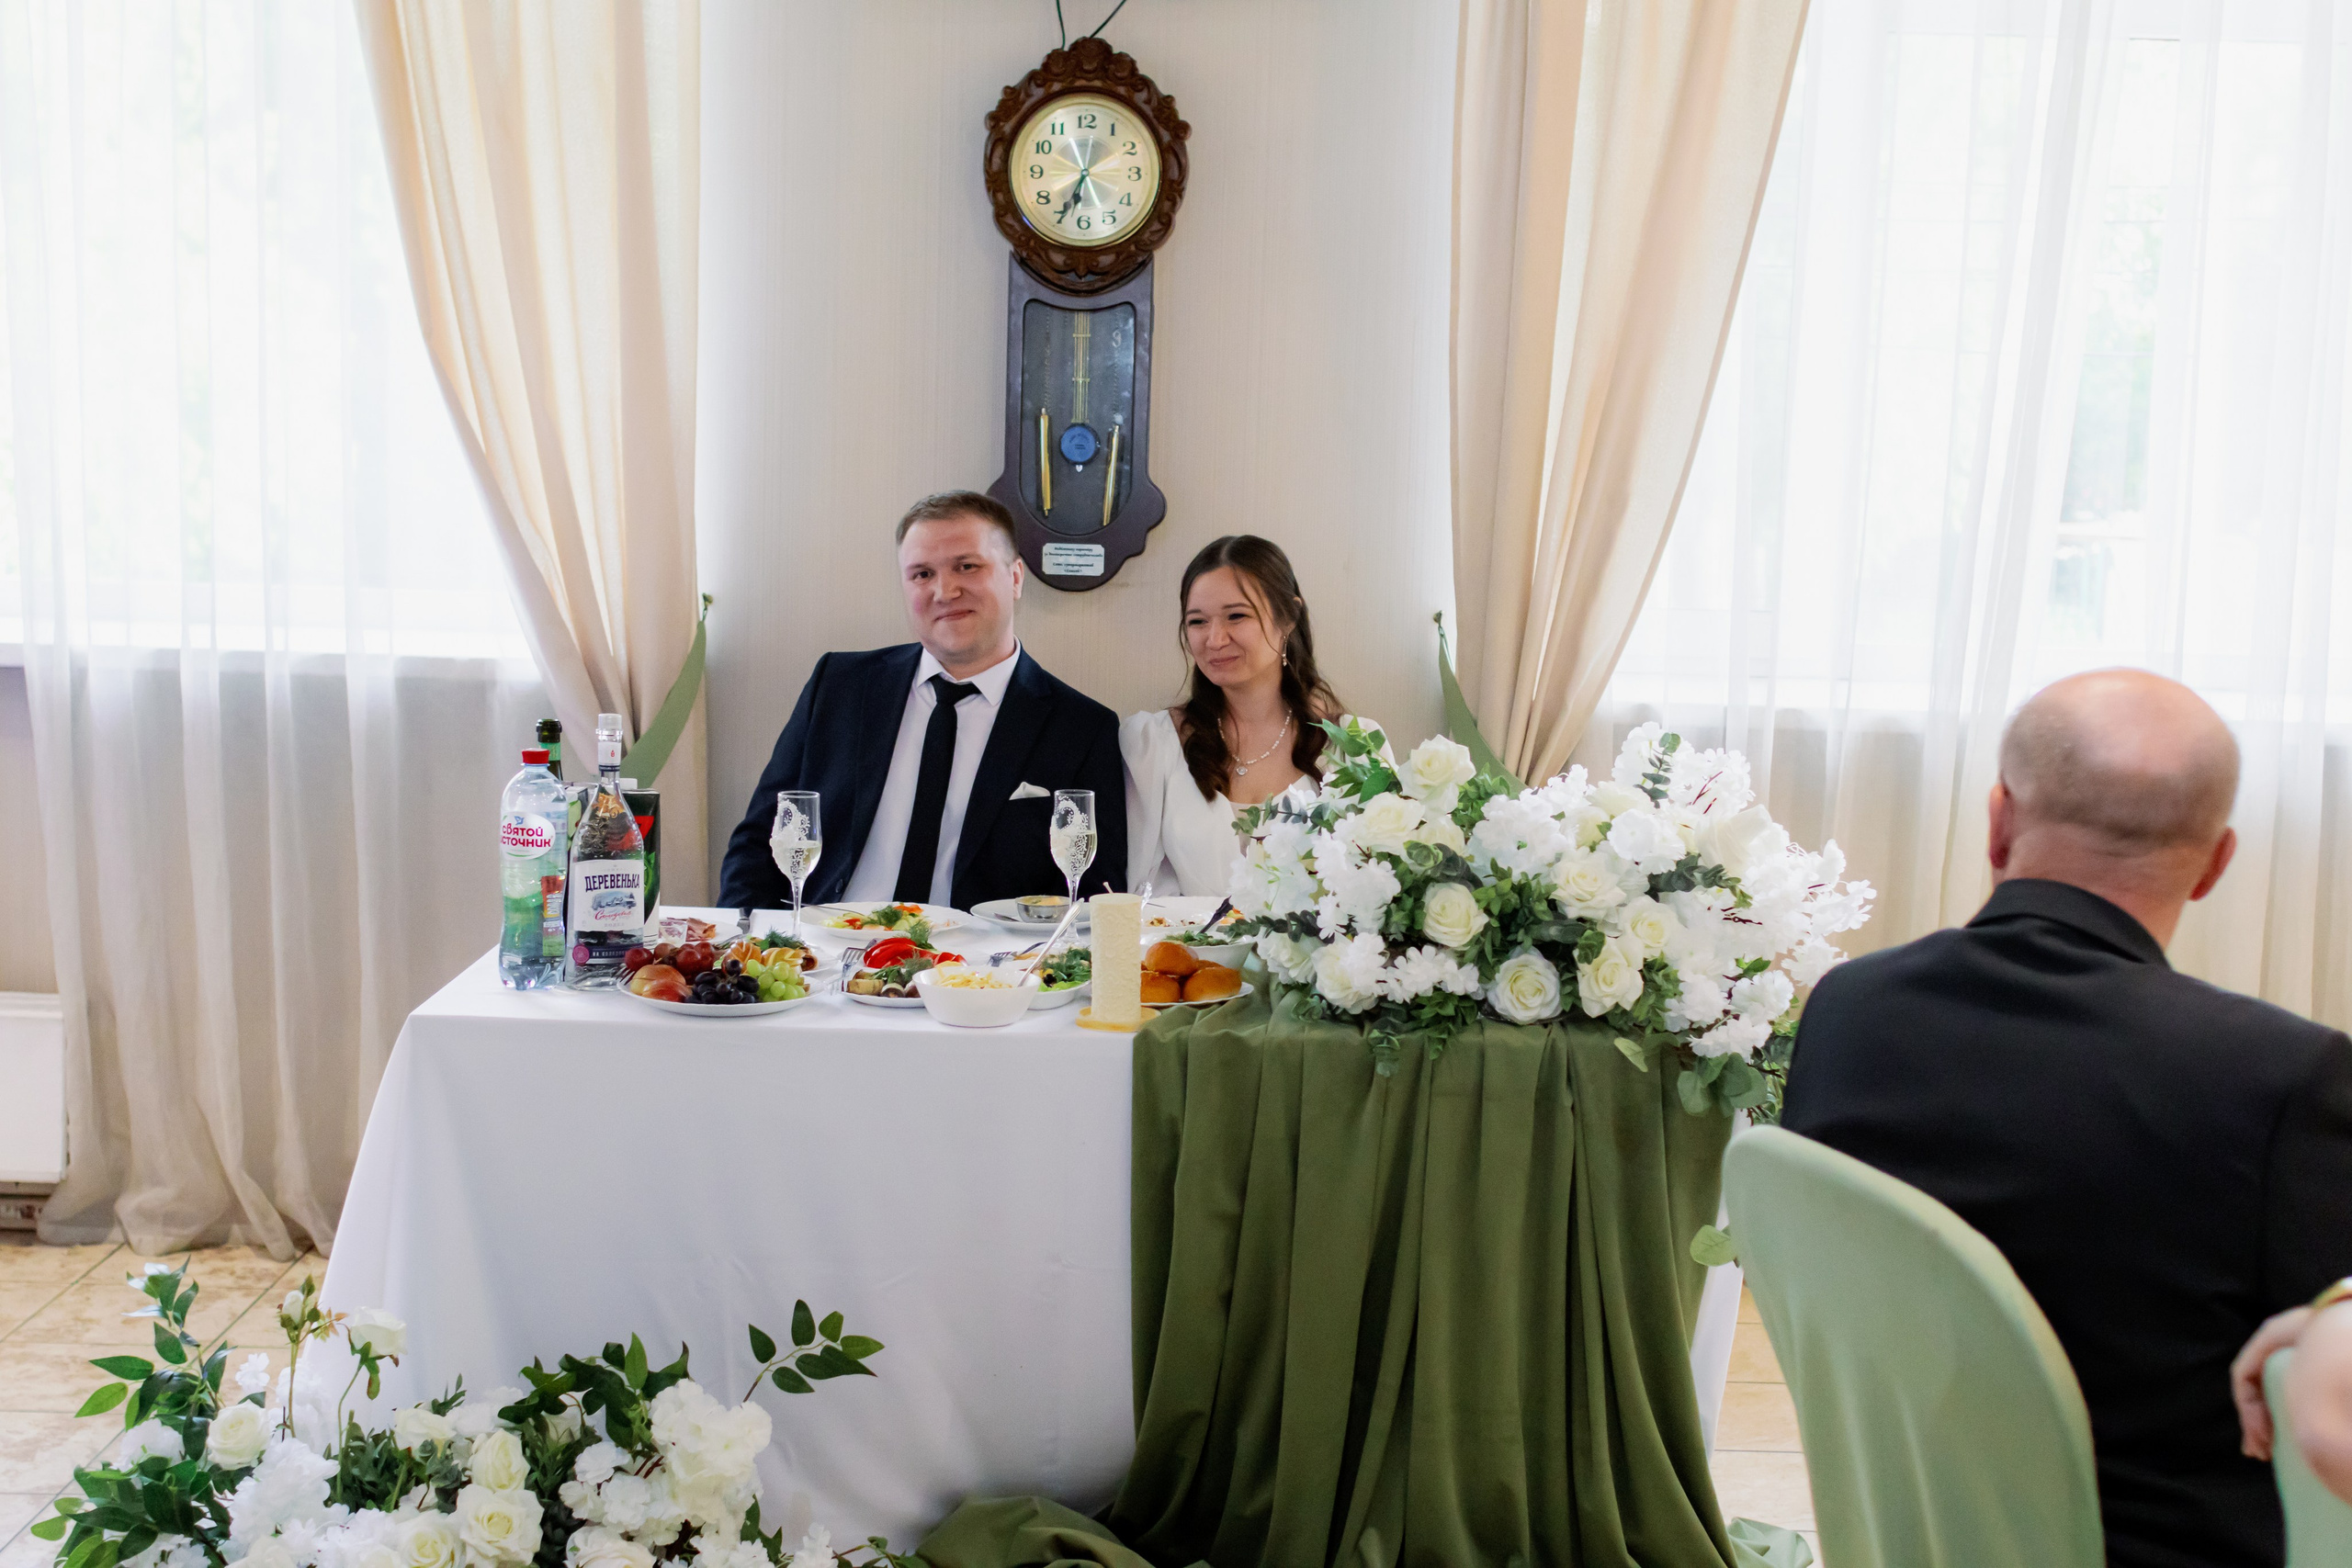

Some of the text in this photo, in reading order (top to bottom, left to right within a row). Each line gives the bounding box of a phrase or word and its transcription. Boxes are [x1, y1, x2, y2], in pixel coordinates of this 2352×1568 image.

[1050, 121, 1065, 136] 11
[1077, 113, 1097, 130] 12
[1110, 122, 1116, 137] 1
[1035, 140, 1052, 155] 10
[1123, 141, 1137, 156] 2
[1030, 164, 1044, 180] 9
[1127, 166, 1142, 182] 3
[1035, 190, 1051, 205] 8
[1119, 192, 1133, 207] 4
[1077, 215, 1091, 231] 6
[1102, 209, 1116, 225] 5
[501, 836, 551, 848] сточник
[584, 874, 640, 893] ДЕРЕВЕНЬКА
